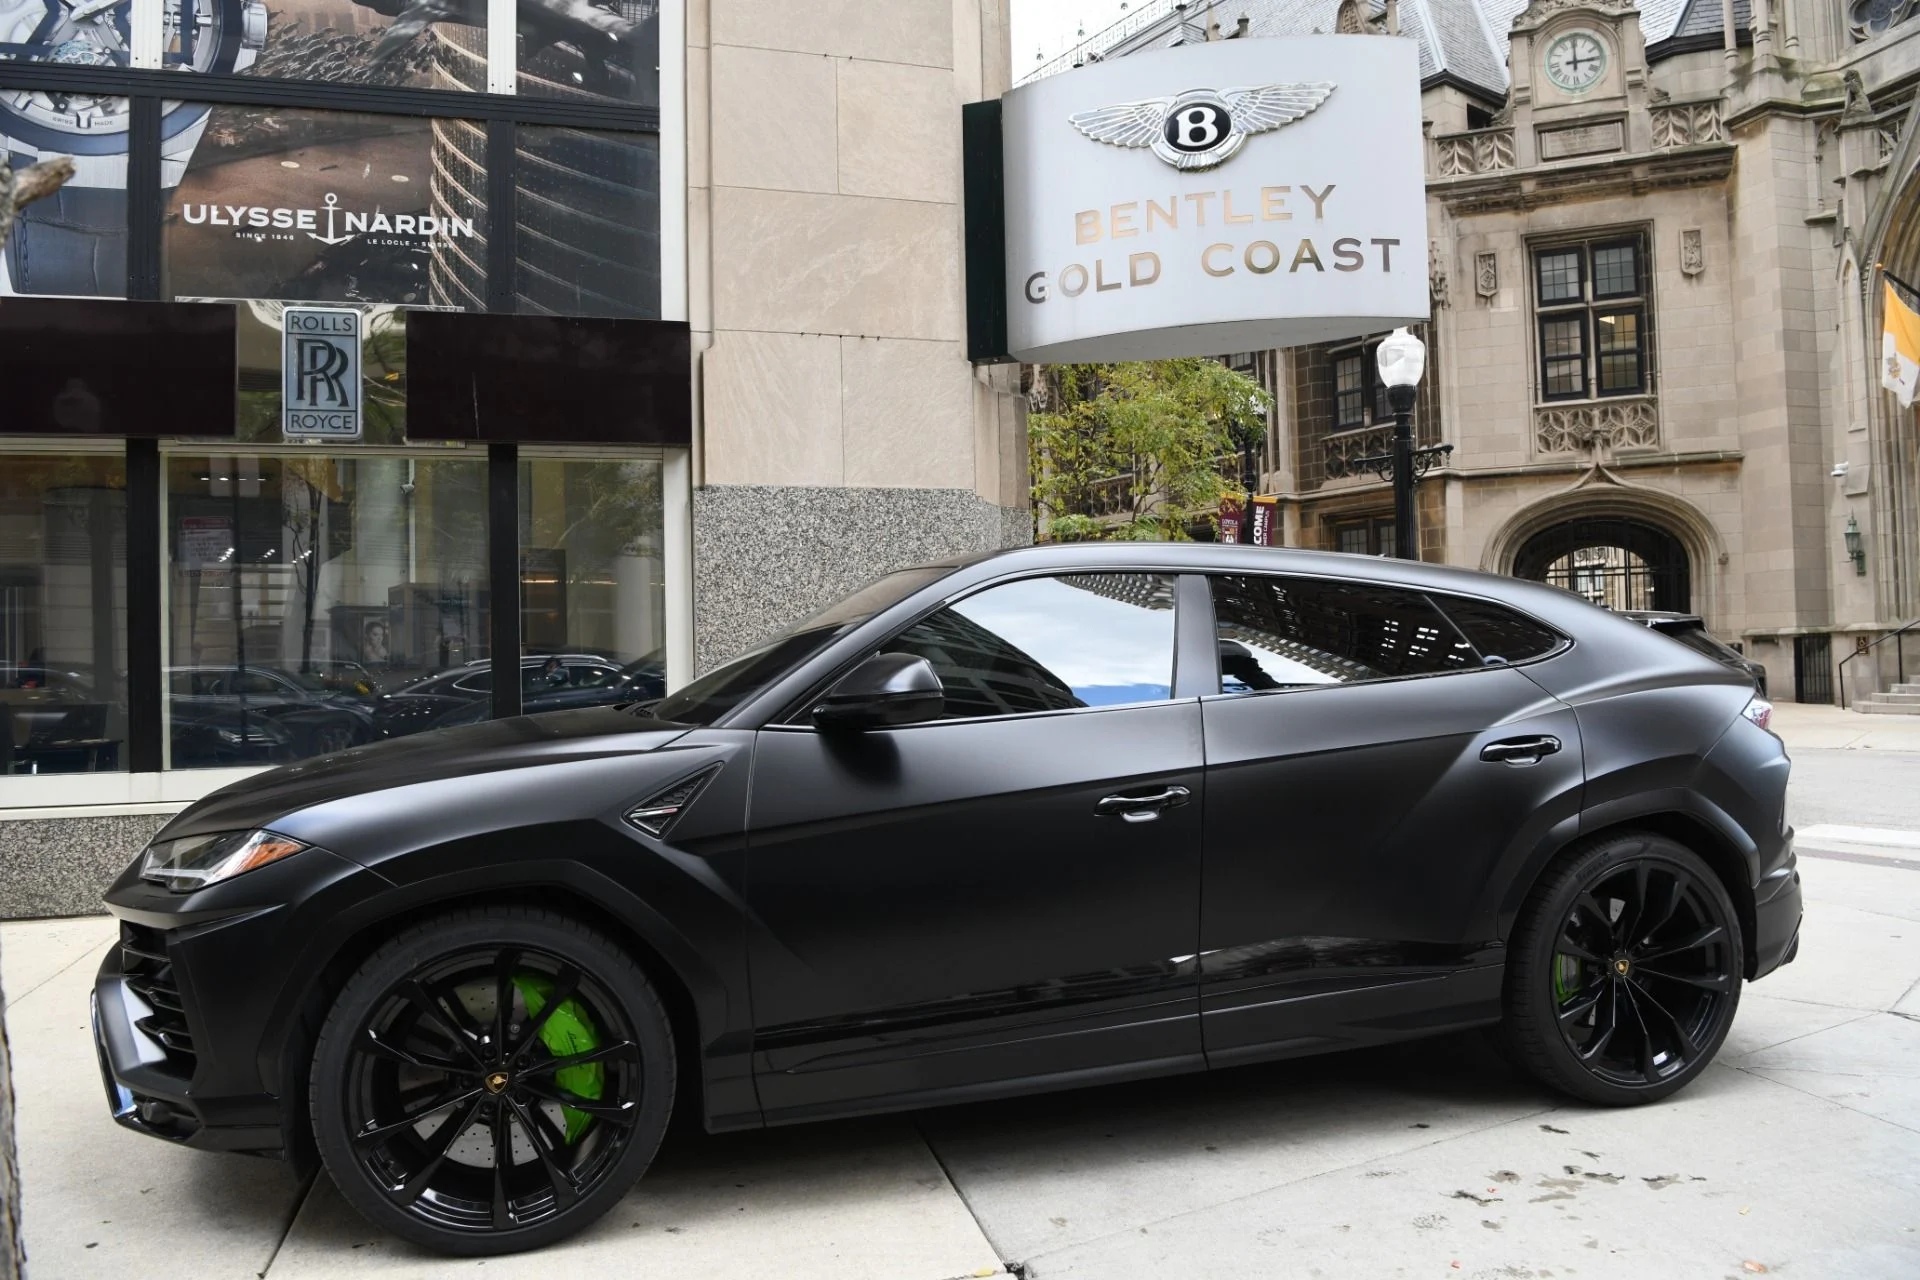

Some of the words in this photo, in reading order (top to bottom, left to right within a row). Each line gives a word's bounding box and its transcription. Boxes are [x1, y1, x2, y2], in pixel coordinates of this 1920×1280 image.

[183, 203, 317, 230] ULYSSE
[345, 211, 473, 238] NARDIN
[1075, 184, 1336, 246] BENTLEY
[235, 232, 266, 240] SINCE
[1024, 251, 1162, 304] GOLD
[1201, 238, 1401, 278] COAST
[291, 315, 352, 332] ROLLS
[291, 414, 353, 430] ROYCE
[1253, 505, 1265, 546] COME
